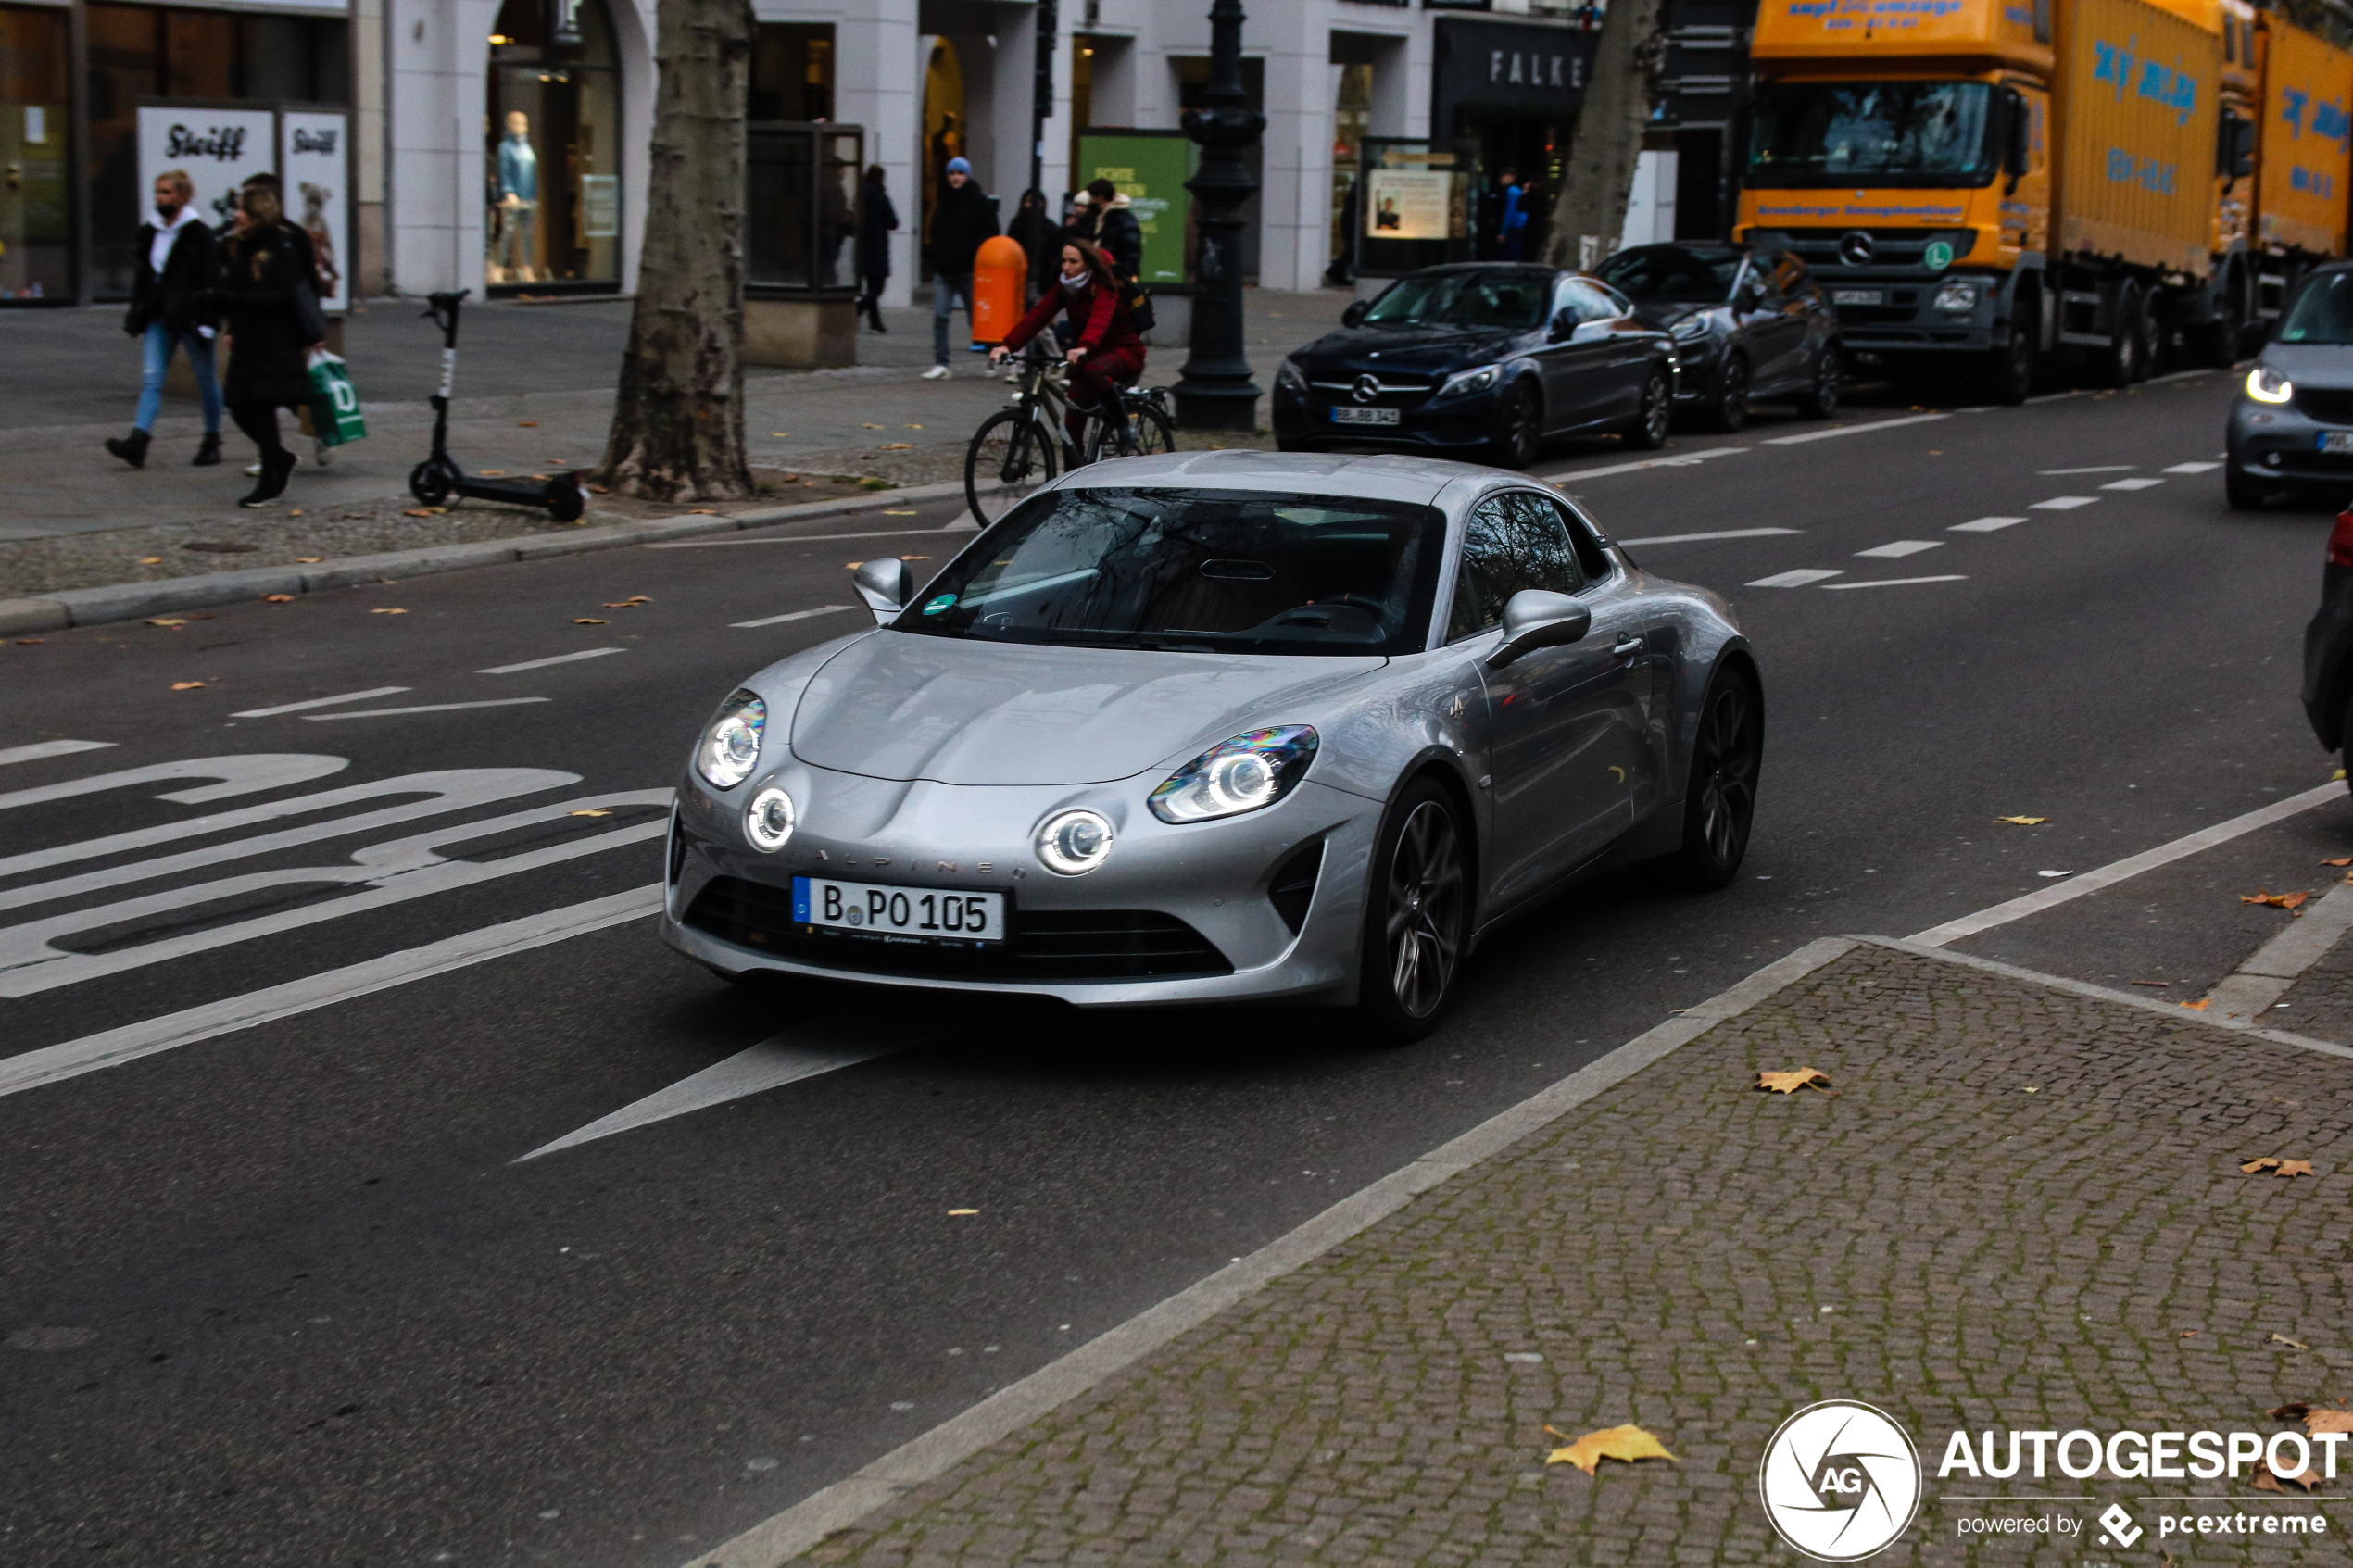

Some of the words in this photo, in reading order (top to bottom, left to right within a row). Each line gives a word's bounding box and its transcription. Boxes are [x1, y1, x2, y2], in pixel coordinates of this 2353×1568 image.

[1491, 50, 1583, 88] FALKE
[165, 124, 246, 161] Steiff
[1932, 246, 1945, 265] L
[330, 380, 357, 412] D
[817, 849, 993, 872] ALPINE
[824, 884, 842, 921] B
[919, 894, 987, 933] 105
